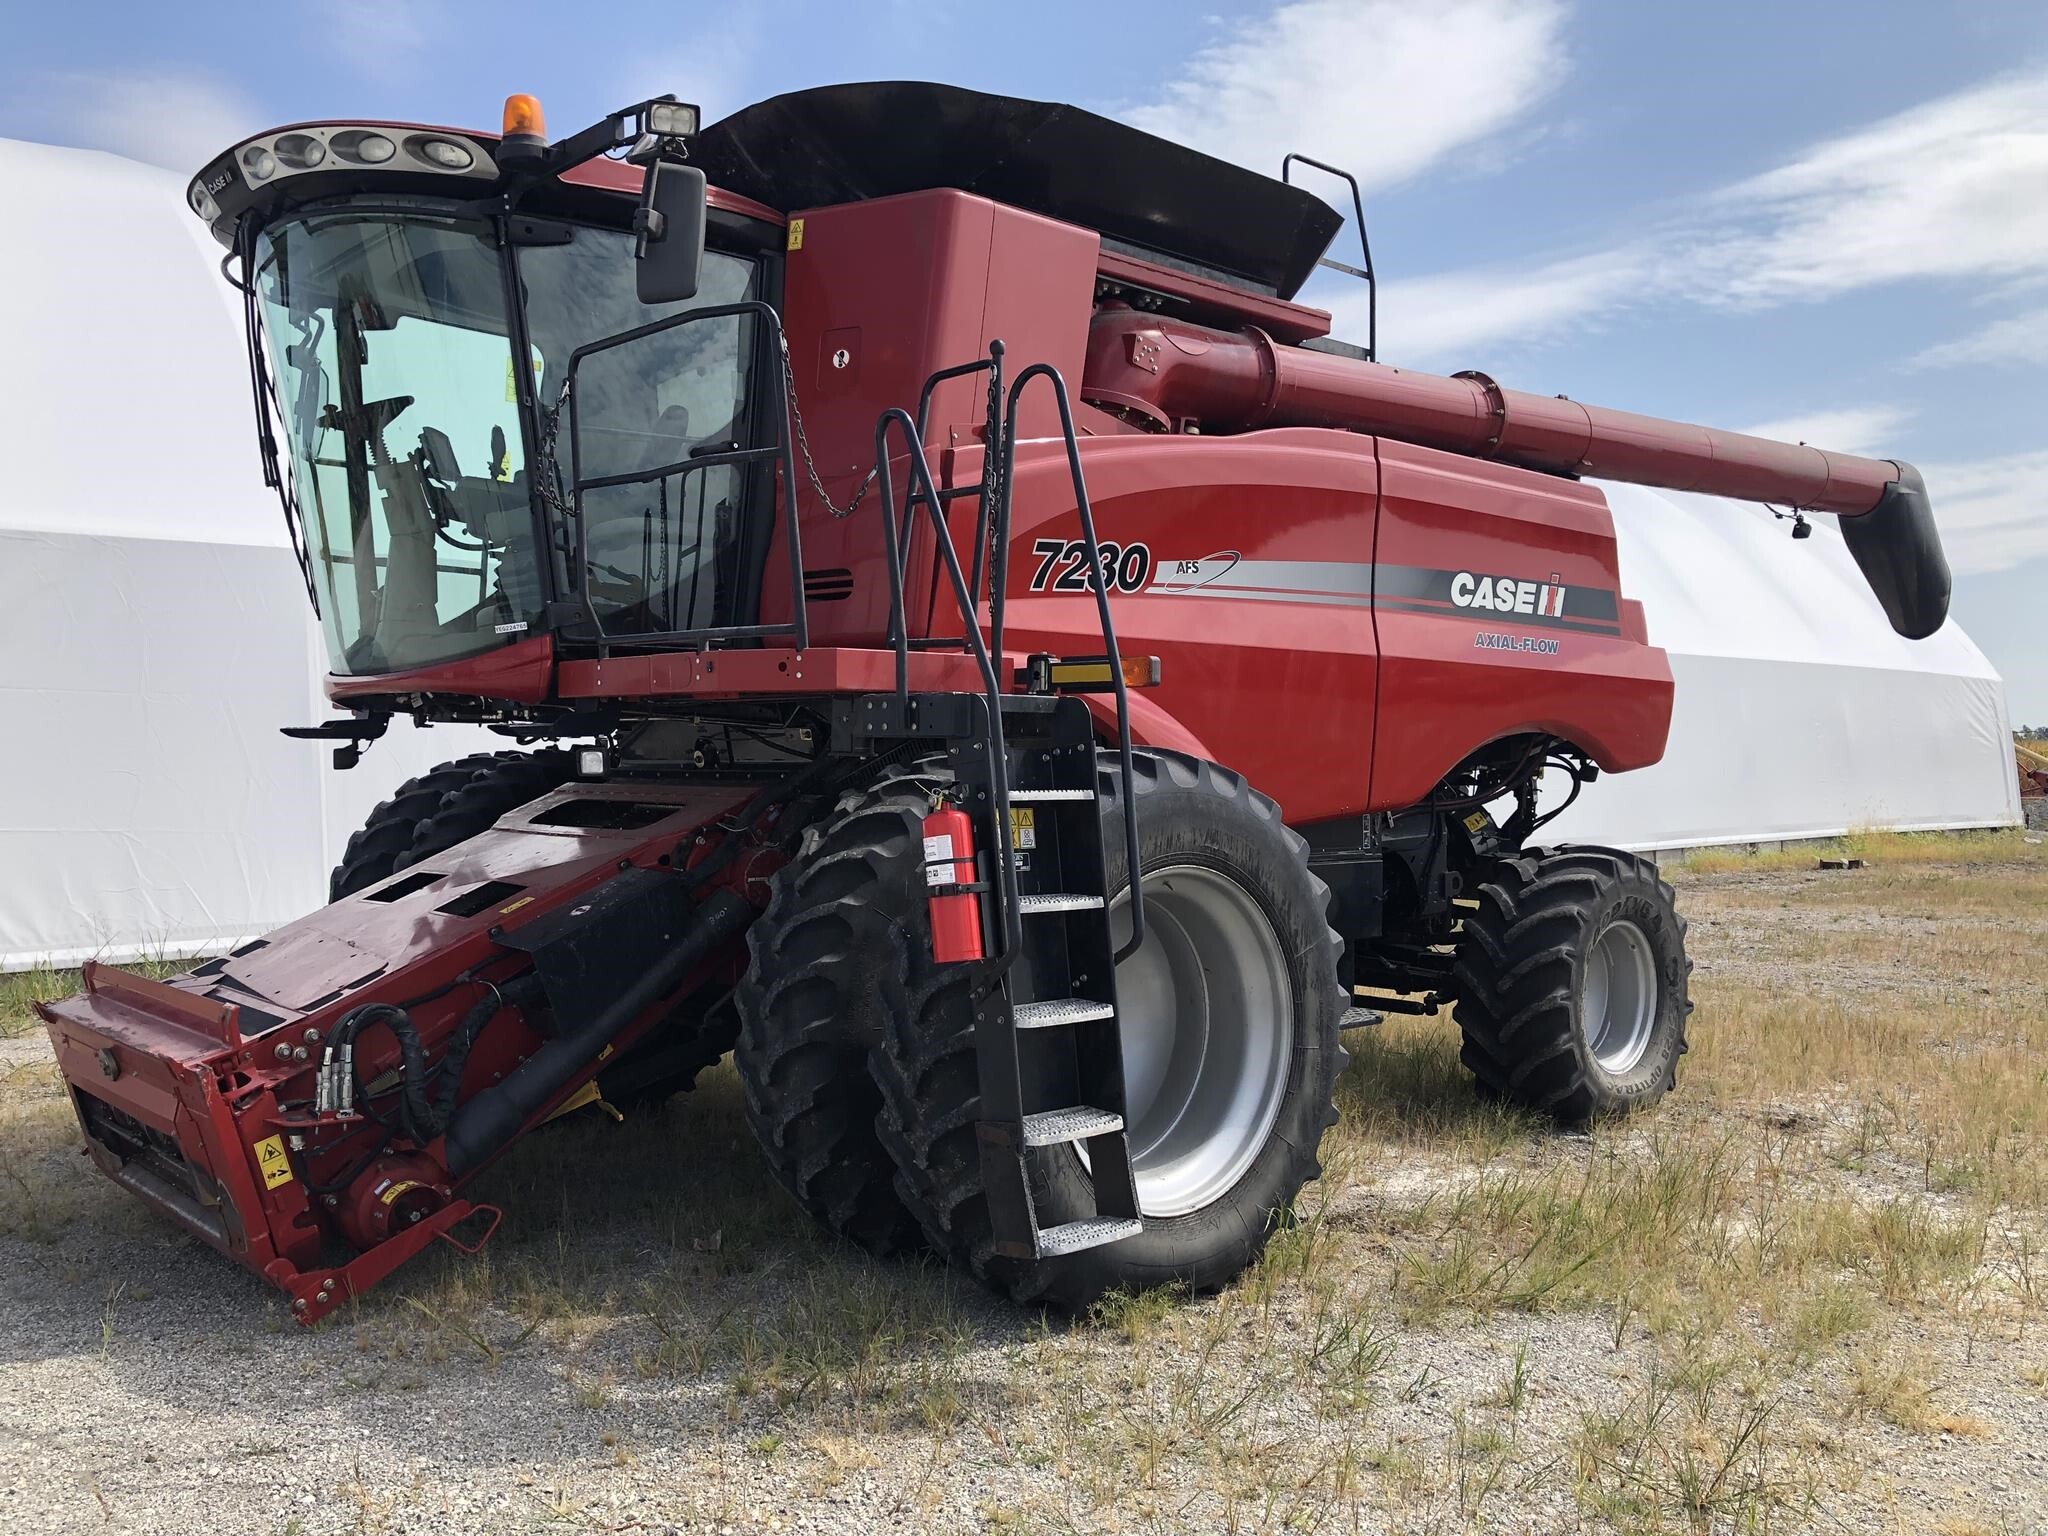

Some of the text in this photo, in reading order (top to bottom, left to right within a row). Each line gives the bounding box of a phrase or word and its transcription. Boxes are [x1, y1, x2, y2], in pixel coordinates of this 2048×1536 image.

[208, 175, 226, 195] CASE
[1029, 538, 1200, 594] 7230 AFS
[1450, 572, 1537, 614] CASE
[1474, 631, 1560, 655] AXIAL-FLOW
